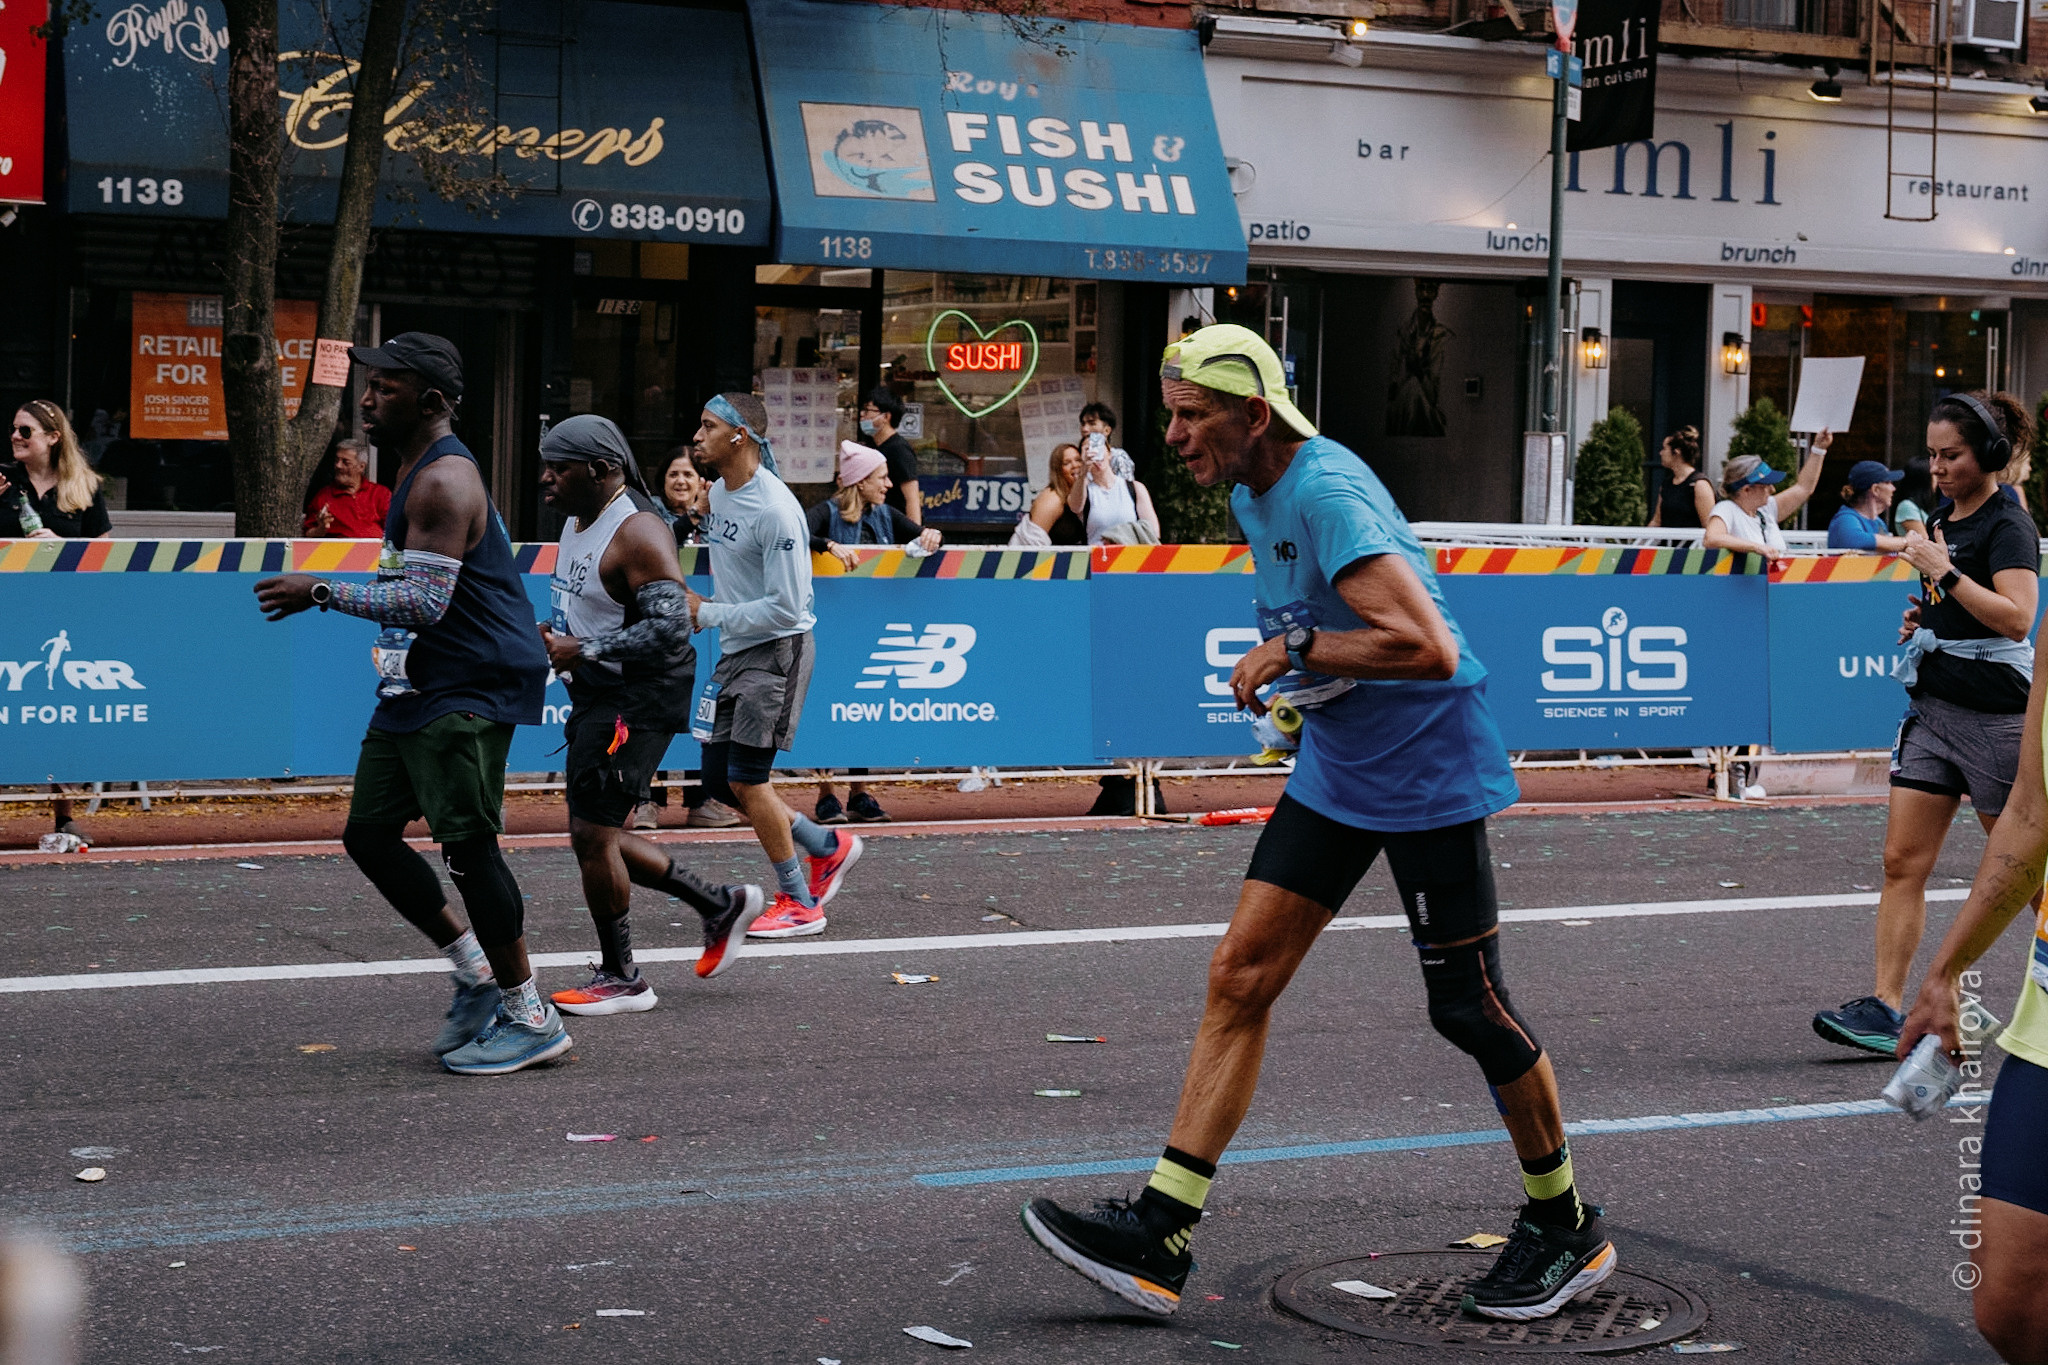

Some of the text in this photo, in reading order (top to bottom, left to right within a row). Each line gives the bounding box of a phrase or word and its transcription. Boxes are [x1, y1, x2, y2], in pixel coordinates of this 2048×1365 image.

[176, 6, 230, 65] Su
[1604, 67, 1648, 86] cuisine
[946, 111, 1186, 163] FISH &
[1358, 138, 1410, 160] bar
[98, 177, 184, 206] 1138
[953, 161, 1197, 215] SUSHI
[1908, 178, 2029, 202] restaurant
[610, 203, 745, 234] 838-0910
[1249, 220, 1311, 242] patio
[1487, 230, 1549, 251] lunch
[819, 236, 873, 260] 1138
[1721, 243, 1797, 264] brunch
[139, 335, 222, 357] RETAIL
[947, 343, 1022, 371] SUSHI
[156, 363, 208, 385] FOR
[21, 705, 77, 724] FOR
[89, 704, 149, 723] LIFE
[831, 697, 995, 723] new balance
[1543, 705, 1687, 719] SCIENCE IN SPORT
